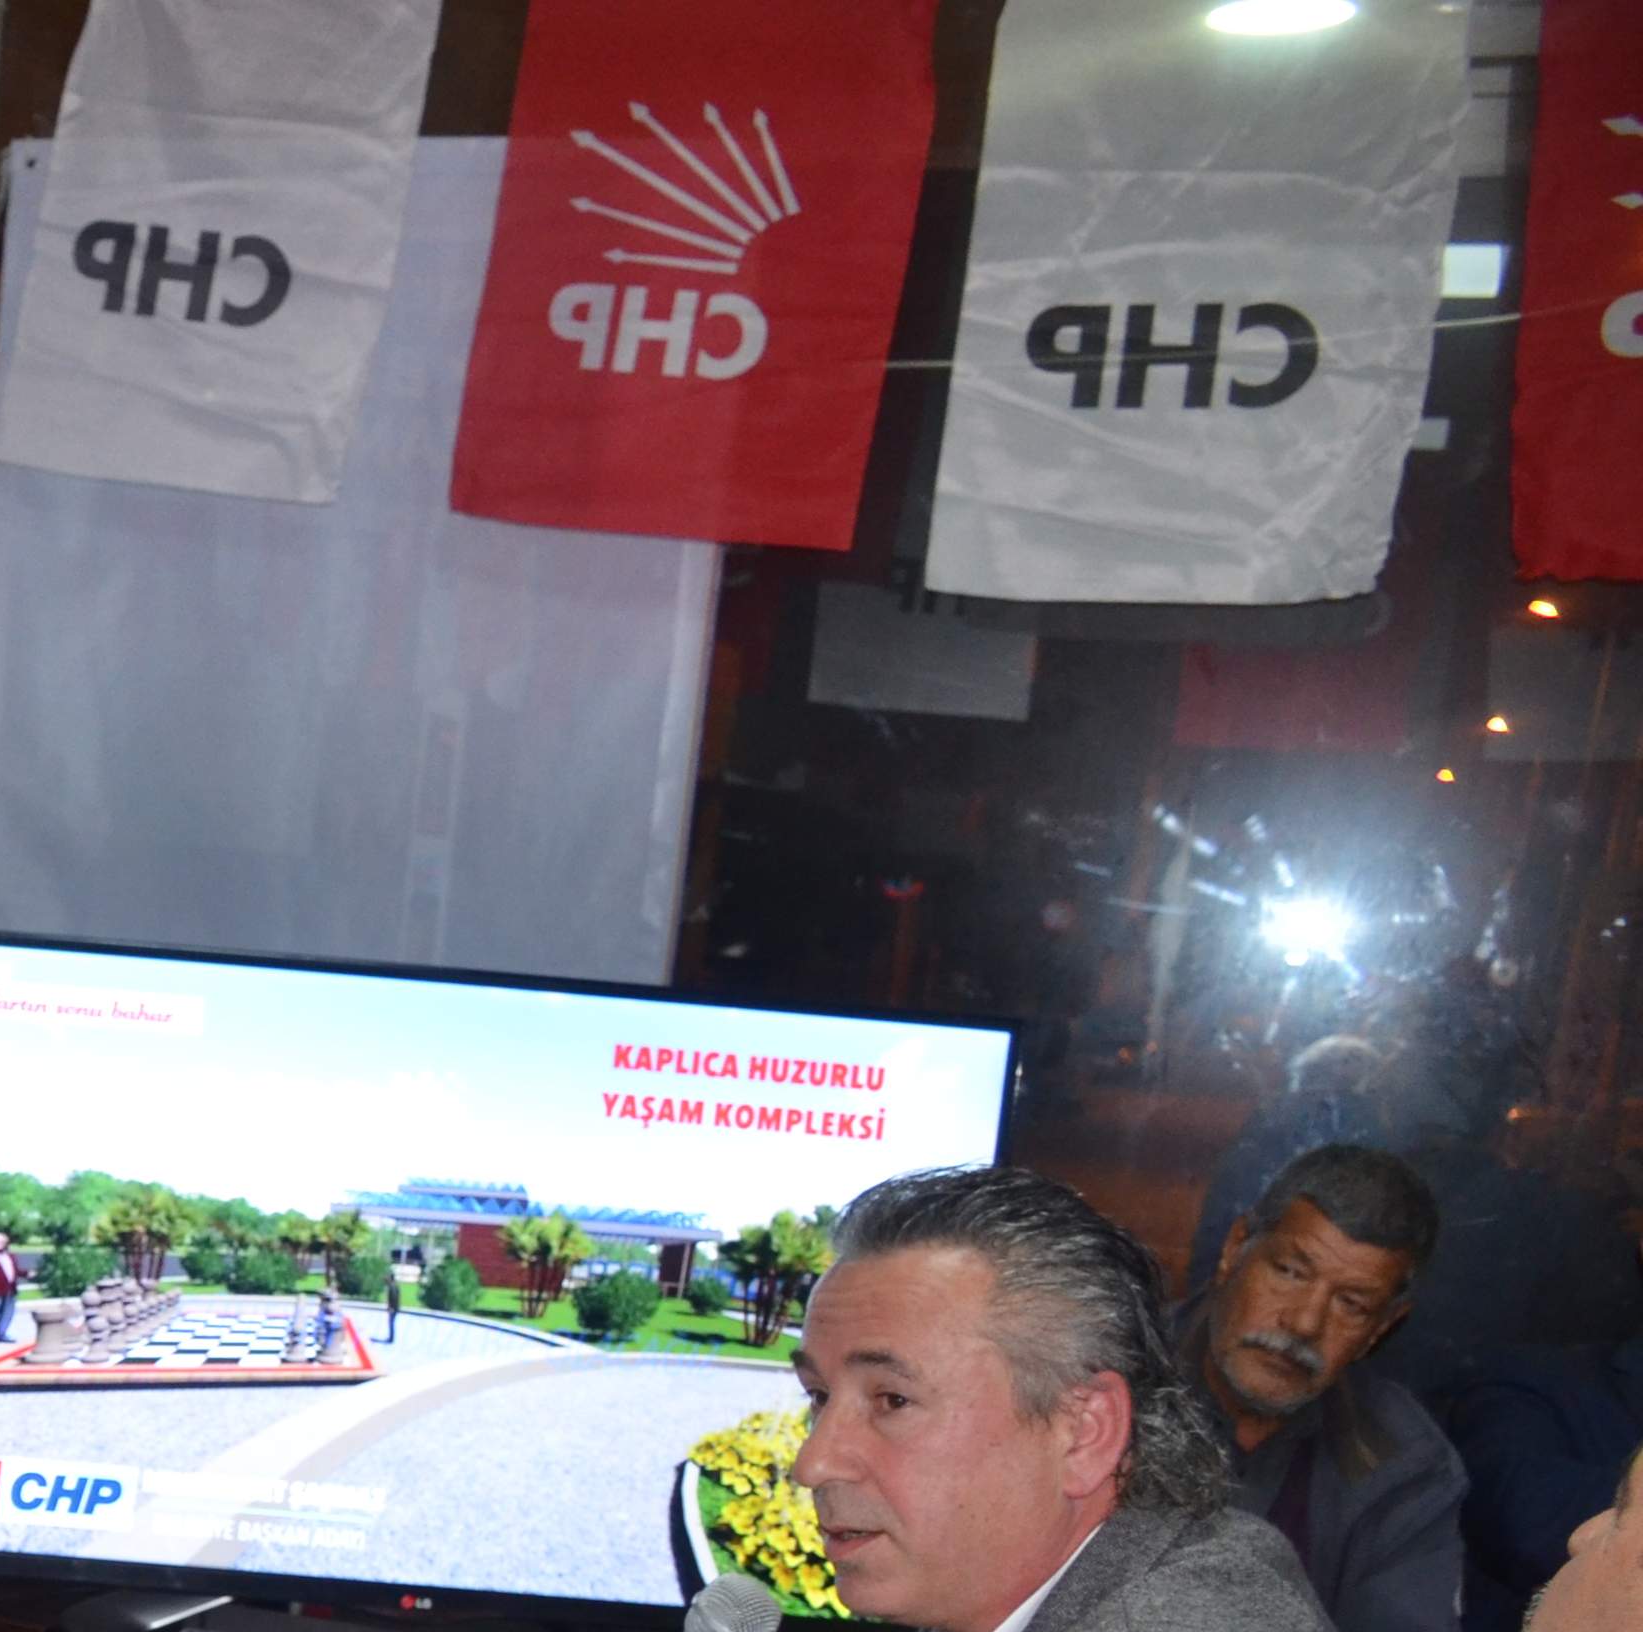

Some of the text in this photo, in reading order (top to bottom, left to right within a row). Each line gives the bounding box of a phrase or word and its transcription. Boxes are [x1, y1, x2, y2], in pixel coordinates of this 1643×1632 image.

[613, 1043, 885, 1092] KAPLICA HUZURLU
[602, 1092, 886, 1141] YAŞAM KOMPLEKSİ
[11, 1471, 122, 1515] CHP
